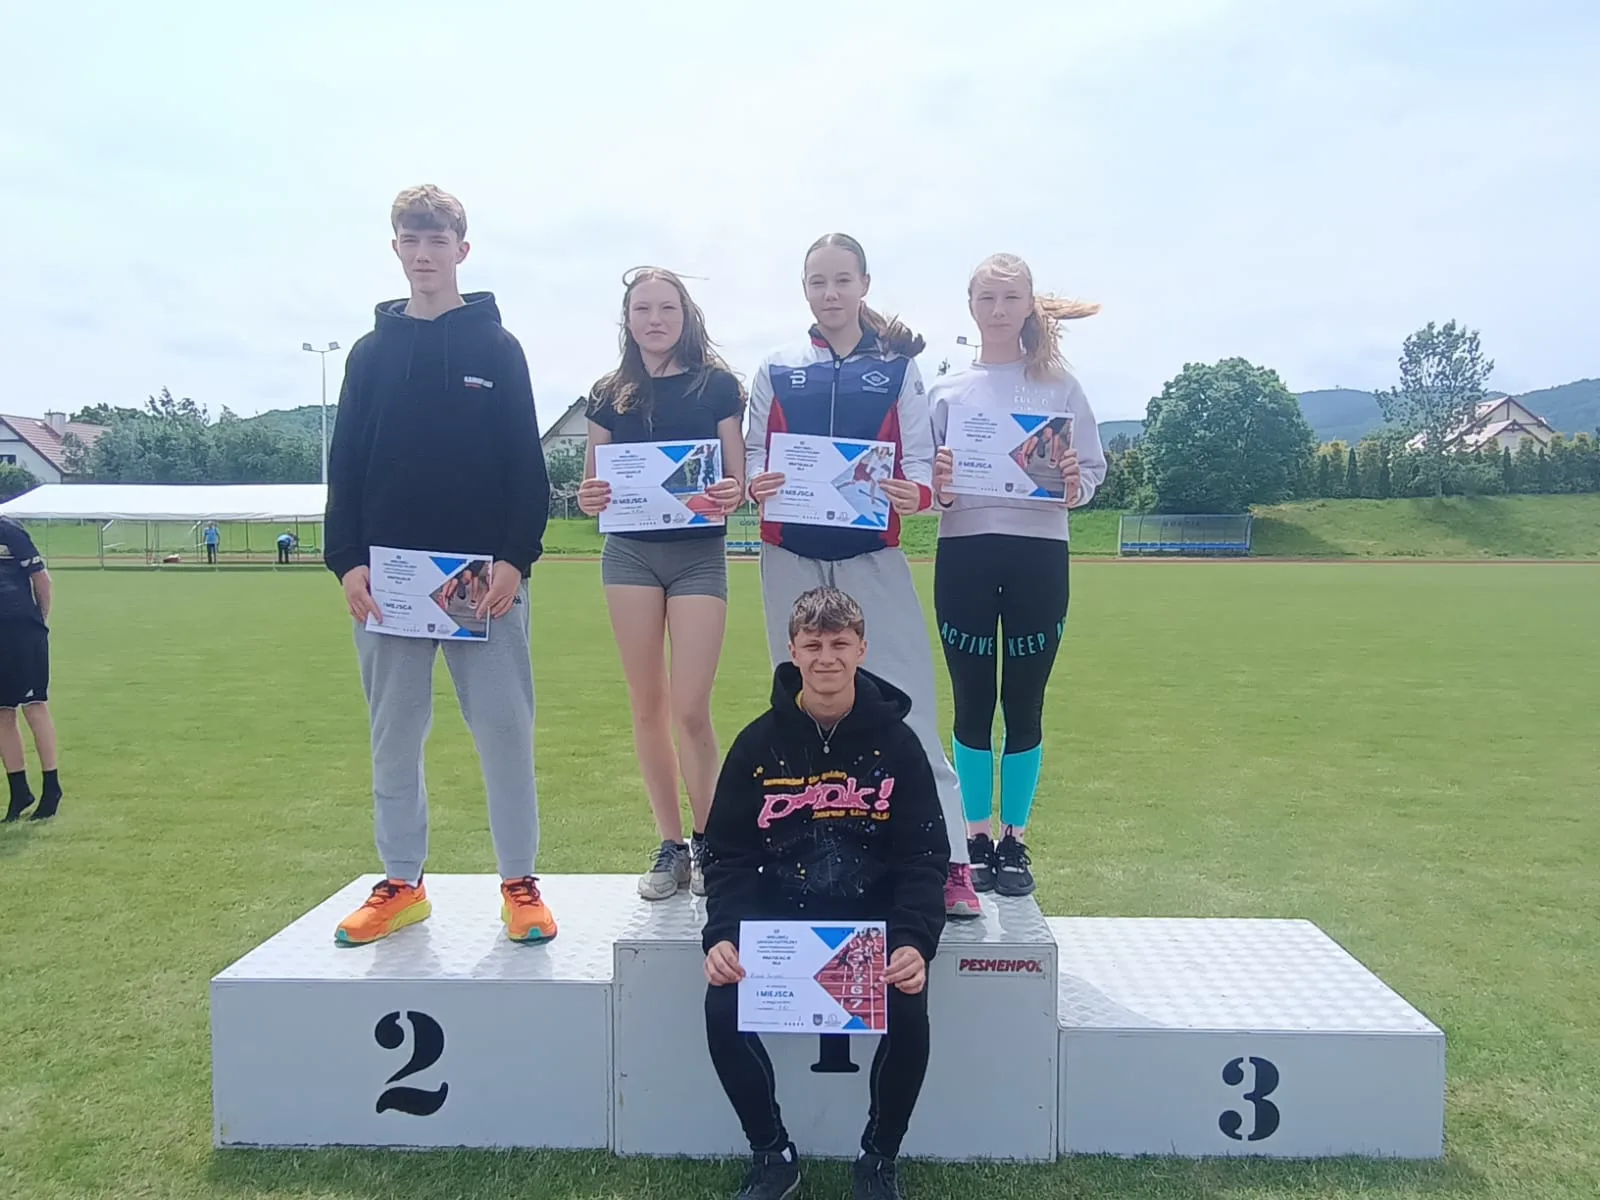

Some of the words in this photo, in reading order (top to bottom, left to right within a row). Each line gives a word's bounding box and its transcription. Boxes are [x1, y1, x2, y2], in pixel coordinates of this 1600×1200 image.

[941, 621, 995, 656] ACTIVE
[1008, 632, 1047, 657] KEEP
[959, 958, 1043, 973] PESMENPOL
[760, 990, 795, 998] MIEJSCA
[374, 1010, 449, 1117] 2
[1218, 1056, 1281, 1142] 3
